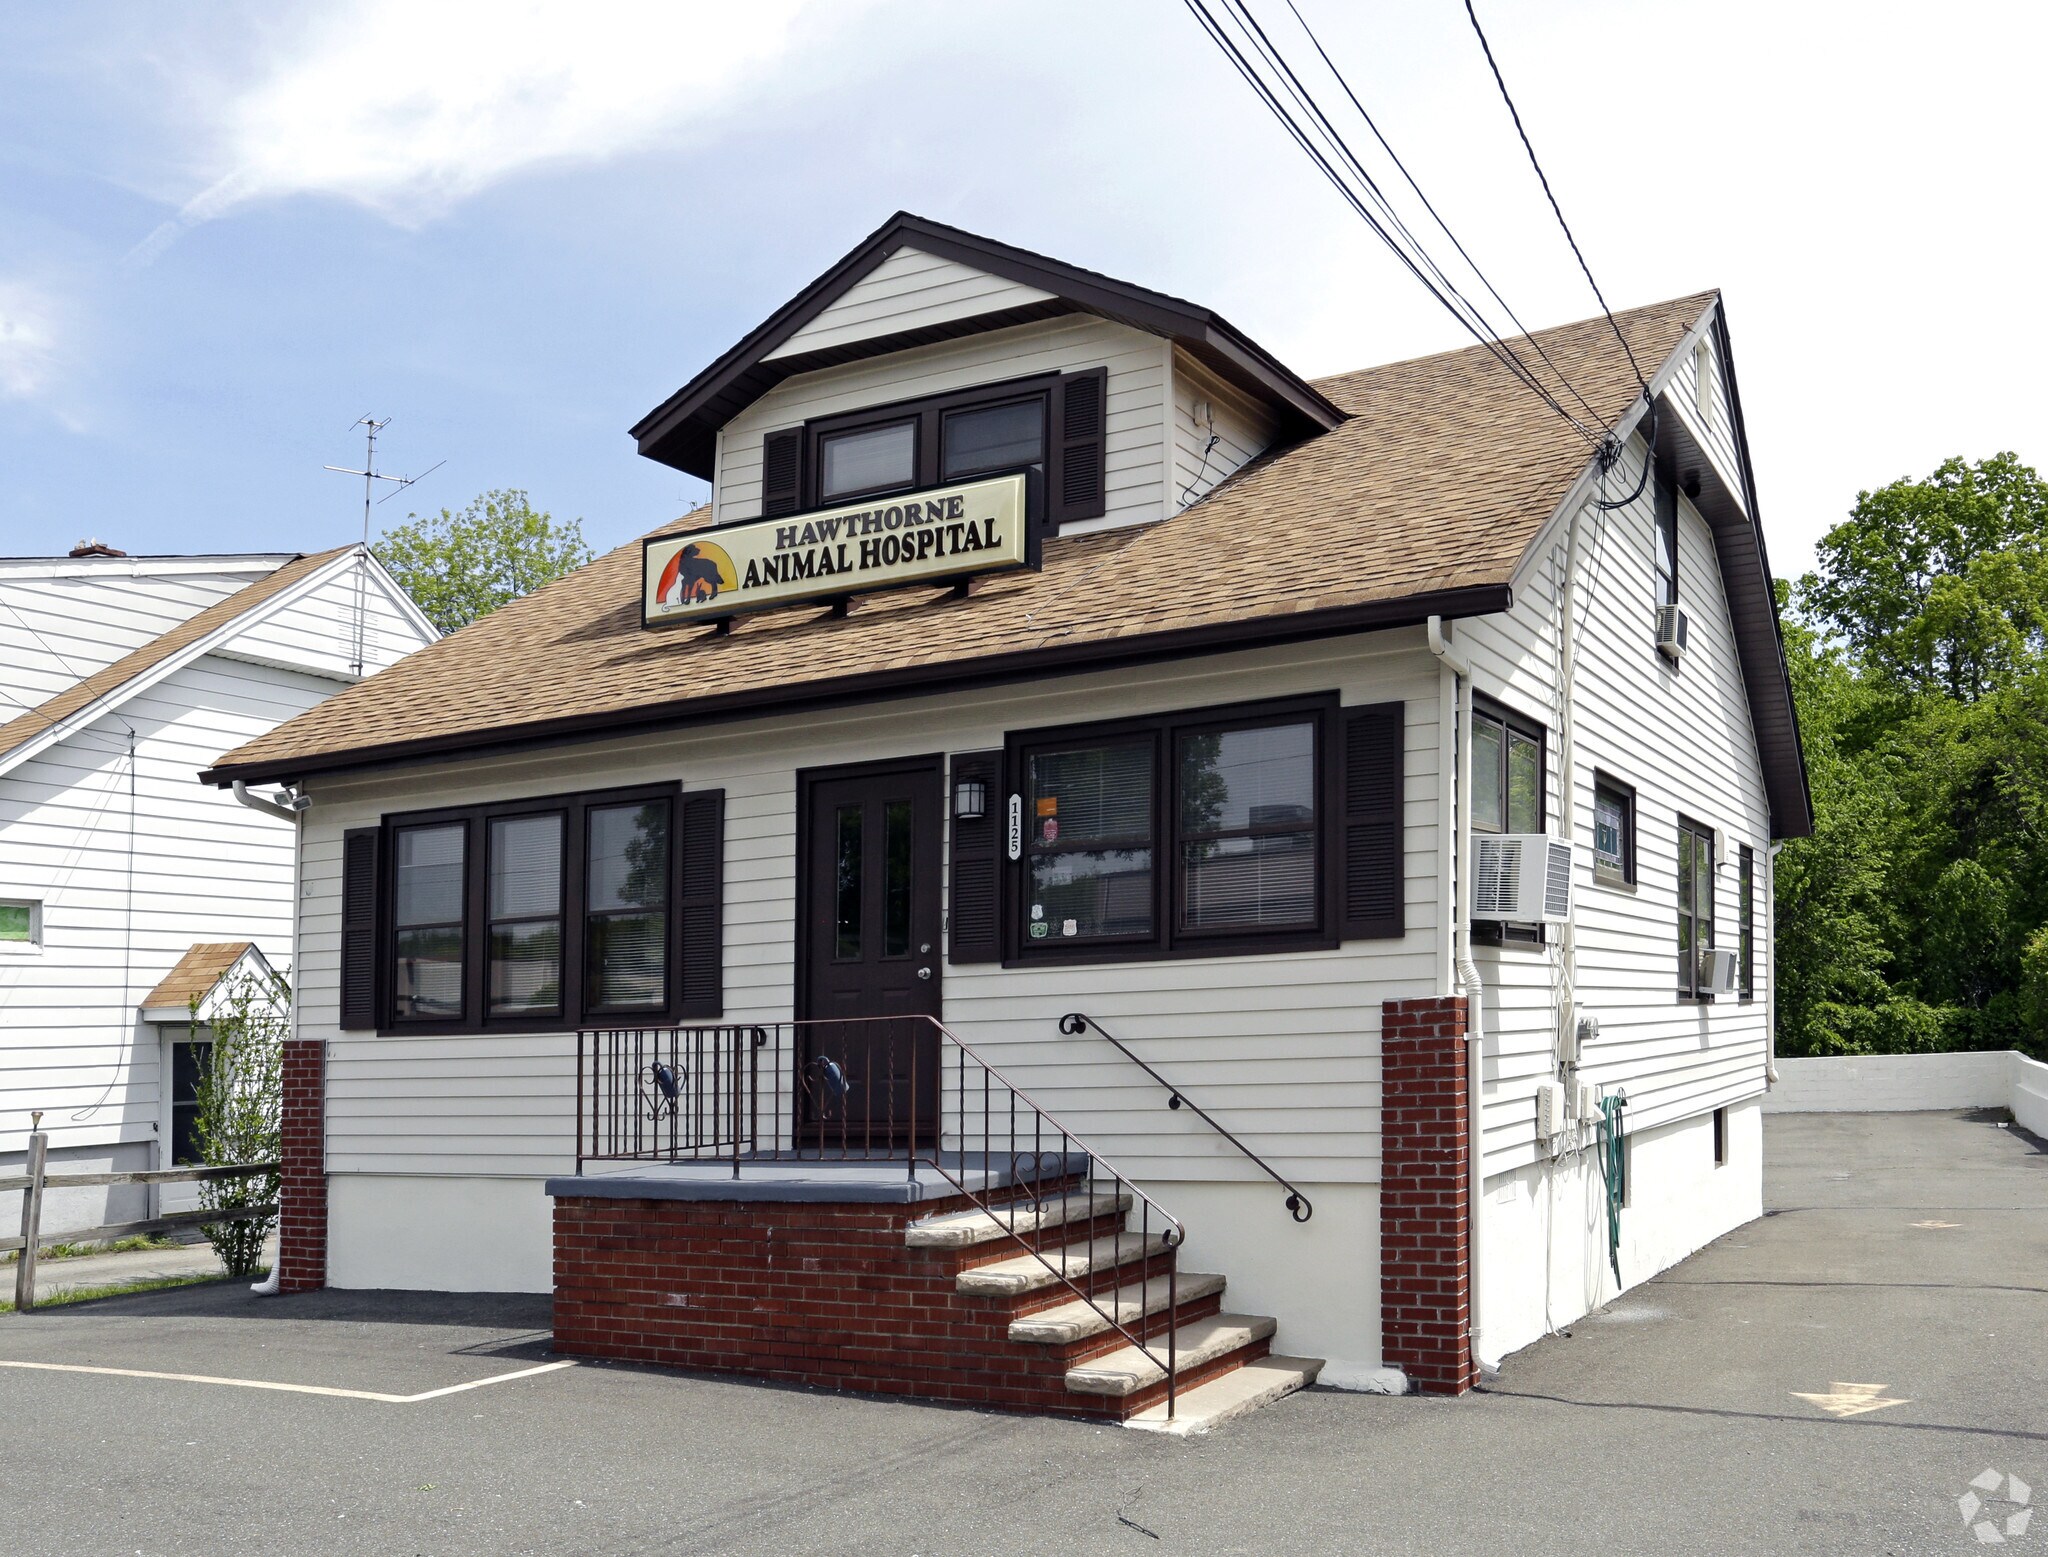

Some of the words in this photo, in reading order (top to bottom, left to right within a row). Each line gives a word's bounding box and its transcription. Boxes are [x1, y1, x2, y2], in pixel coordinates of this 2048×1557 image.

[776, 495, 964, 550] HAWTHORNE
[742, 543, 853, 589] ANIMAL
[859, 517, 1002, 570] HOSPITAL
[1010, 802, 1019, 852] 1125
